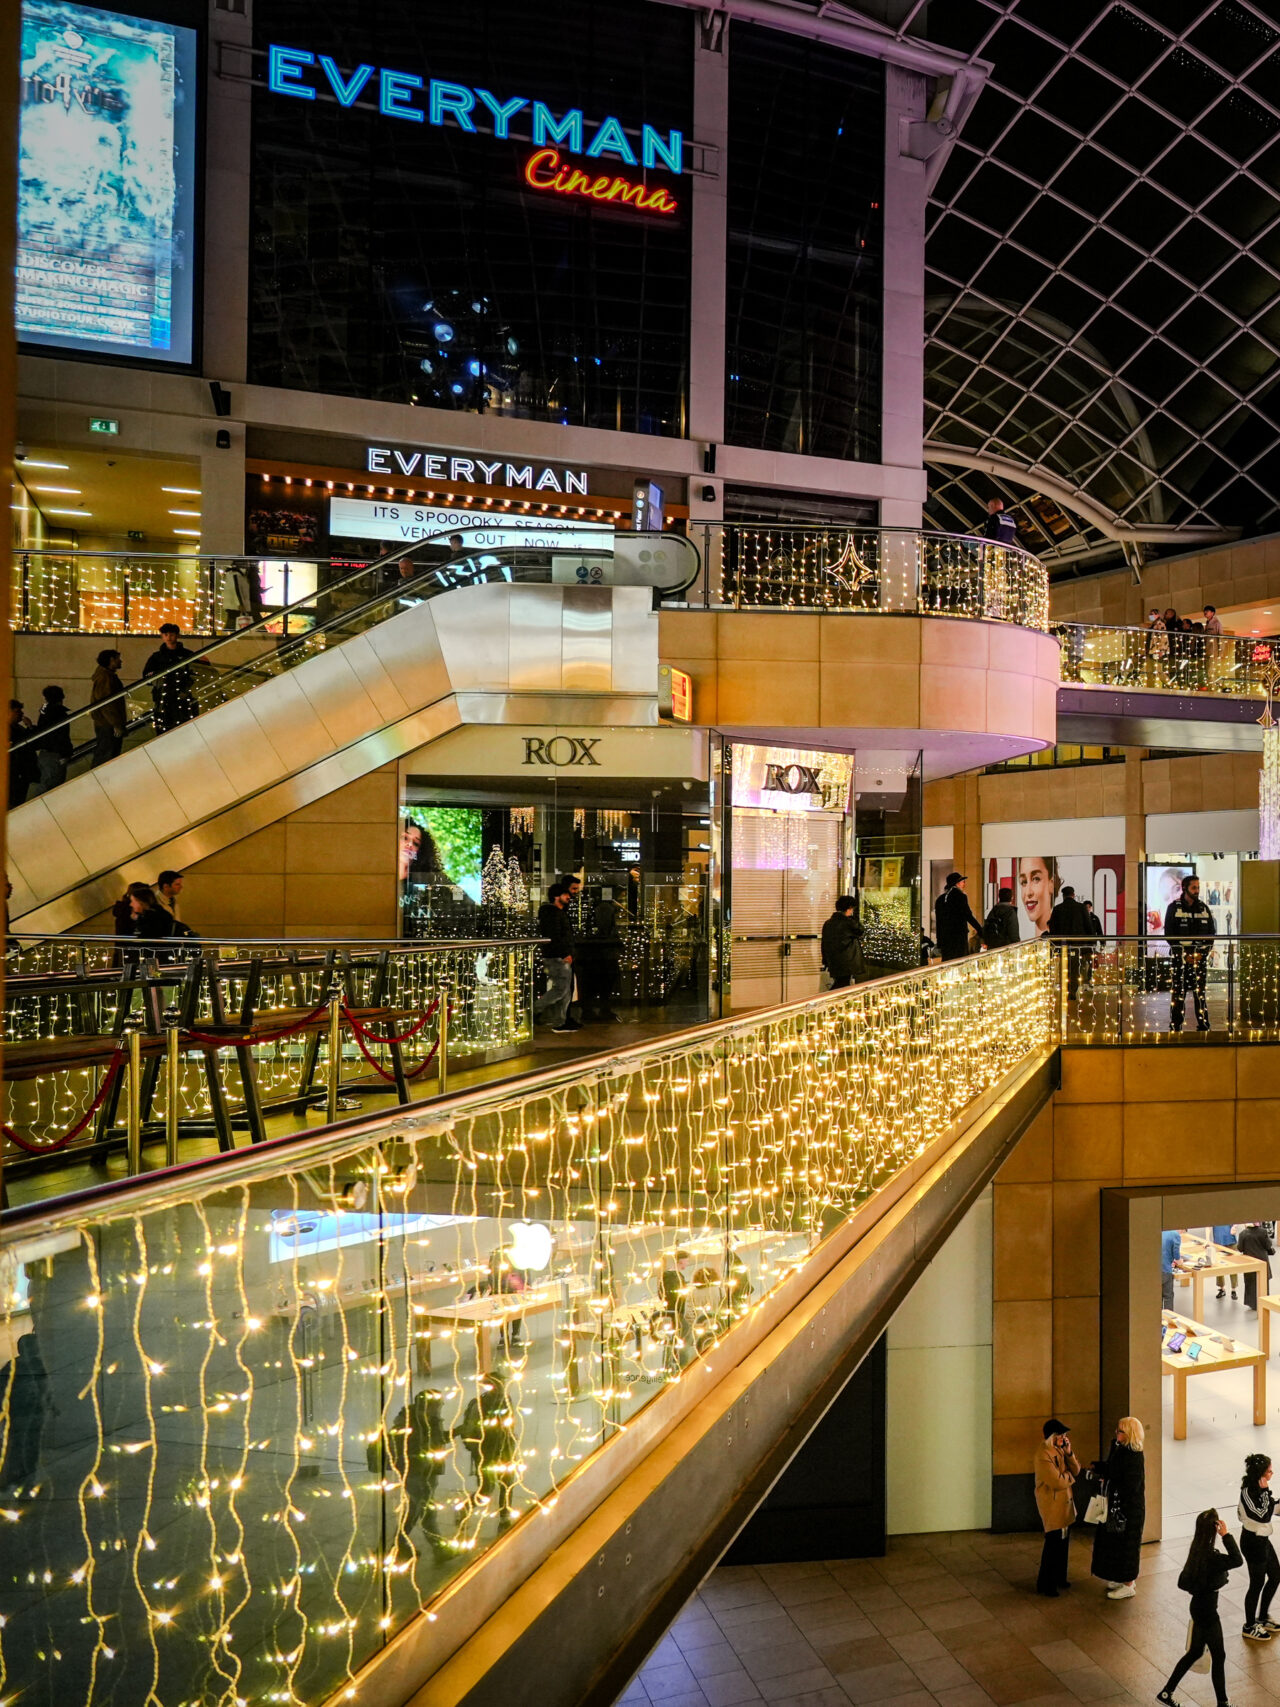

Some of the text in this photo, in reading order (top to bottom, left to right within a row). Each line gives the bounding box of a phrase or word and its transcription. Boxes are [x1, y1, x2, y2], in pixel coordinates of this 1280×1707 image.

[268, 44, 682, 174] EVERYMAN
[525, 148, 678, 213] Cinema
[19, 254, 108, 275] DISCOVER
[93, 278, 148, 297] MAGIC
[368, 447, 588, 495] EVERYMAN
[374, 506, 400, 520] ITS
[414, 510, 503, 527] SPOOOOKY
[475, 533, 506, 545] OUT
[524, 537, 560, 548] NOW
[522, 736, 601, 766] ROX
[761, 764, 824, 794] ROX
